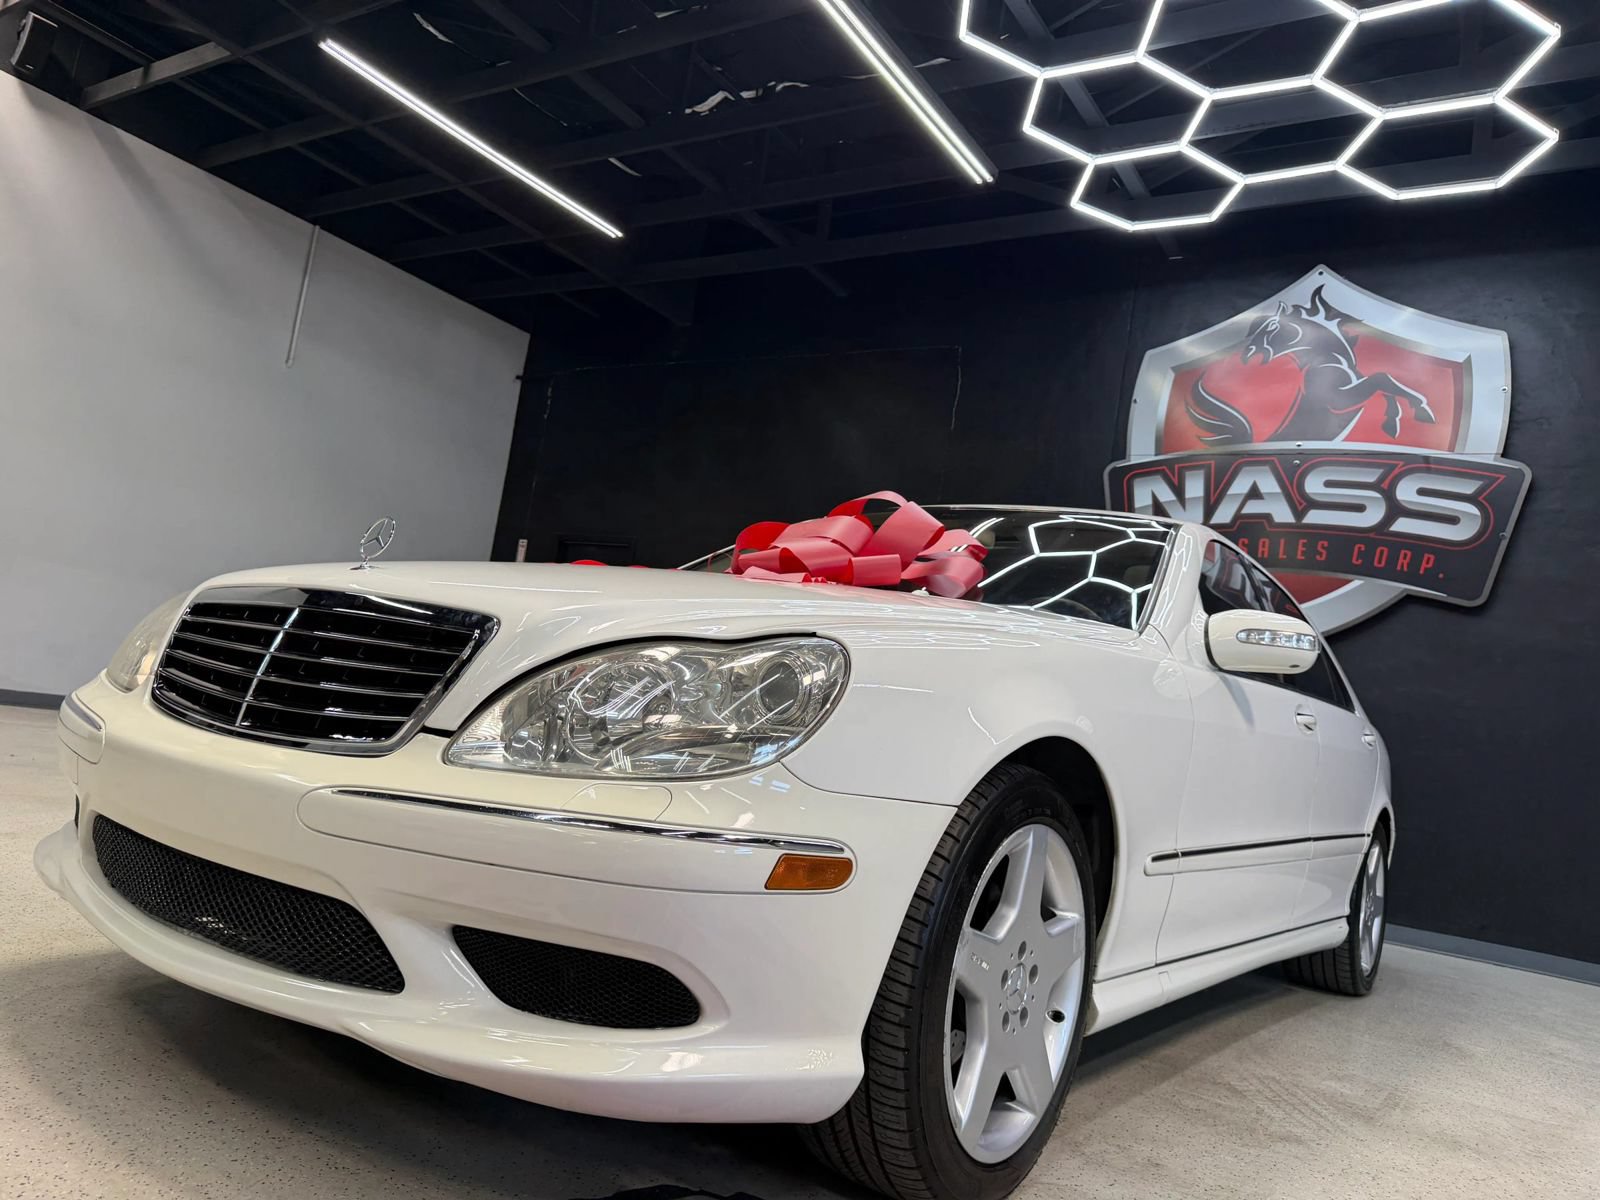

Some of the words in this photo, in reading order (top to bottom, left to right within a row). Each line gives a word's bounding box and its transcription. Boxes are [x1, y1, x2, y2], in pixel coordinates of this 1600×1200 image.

[1133, 466, 1484, 541] NASS
[1238, 538, 1329, 561] SALES
[1351, 544, 1445, 579] CORP.
